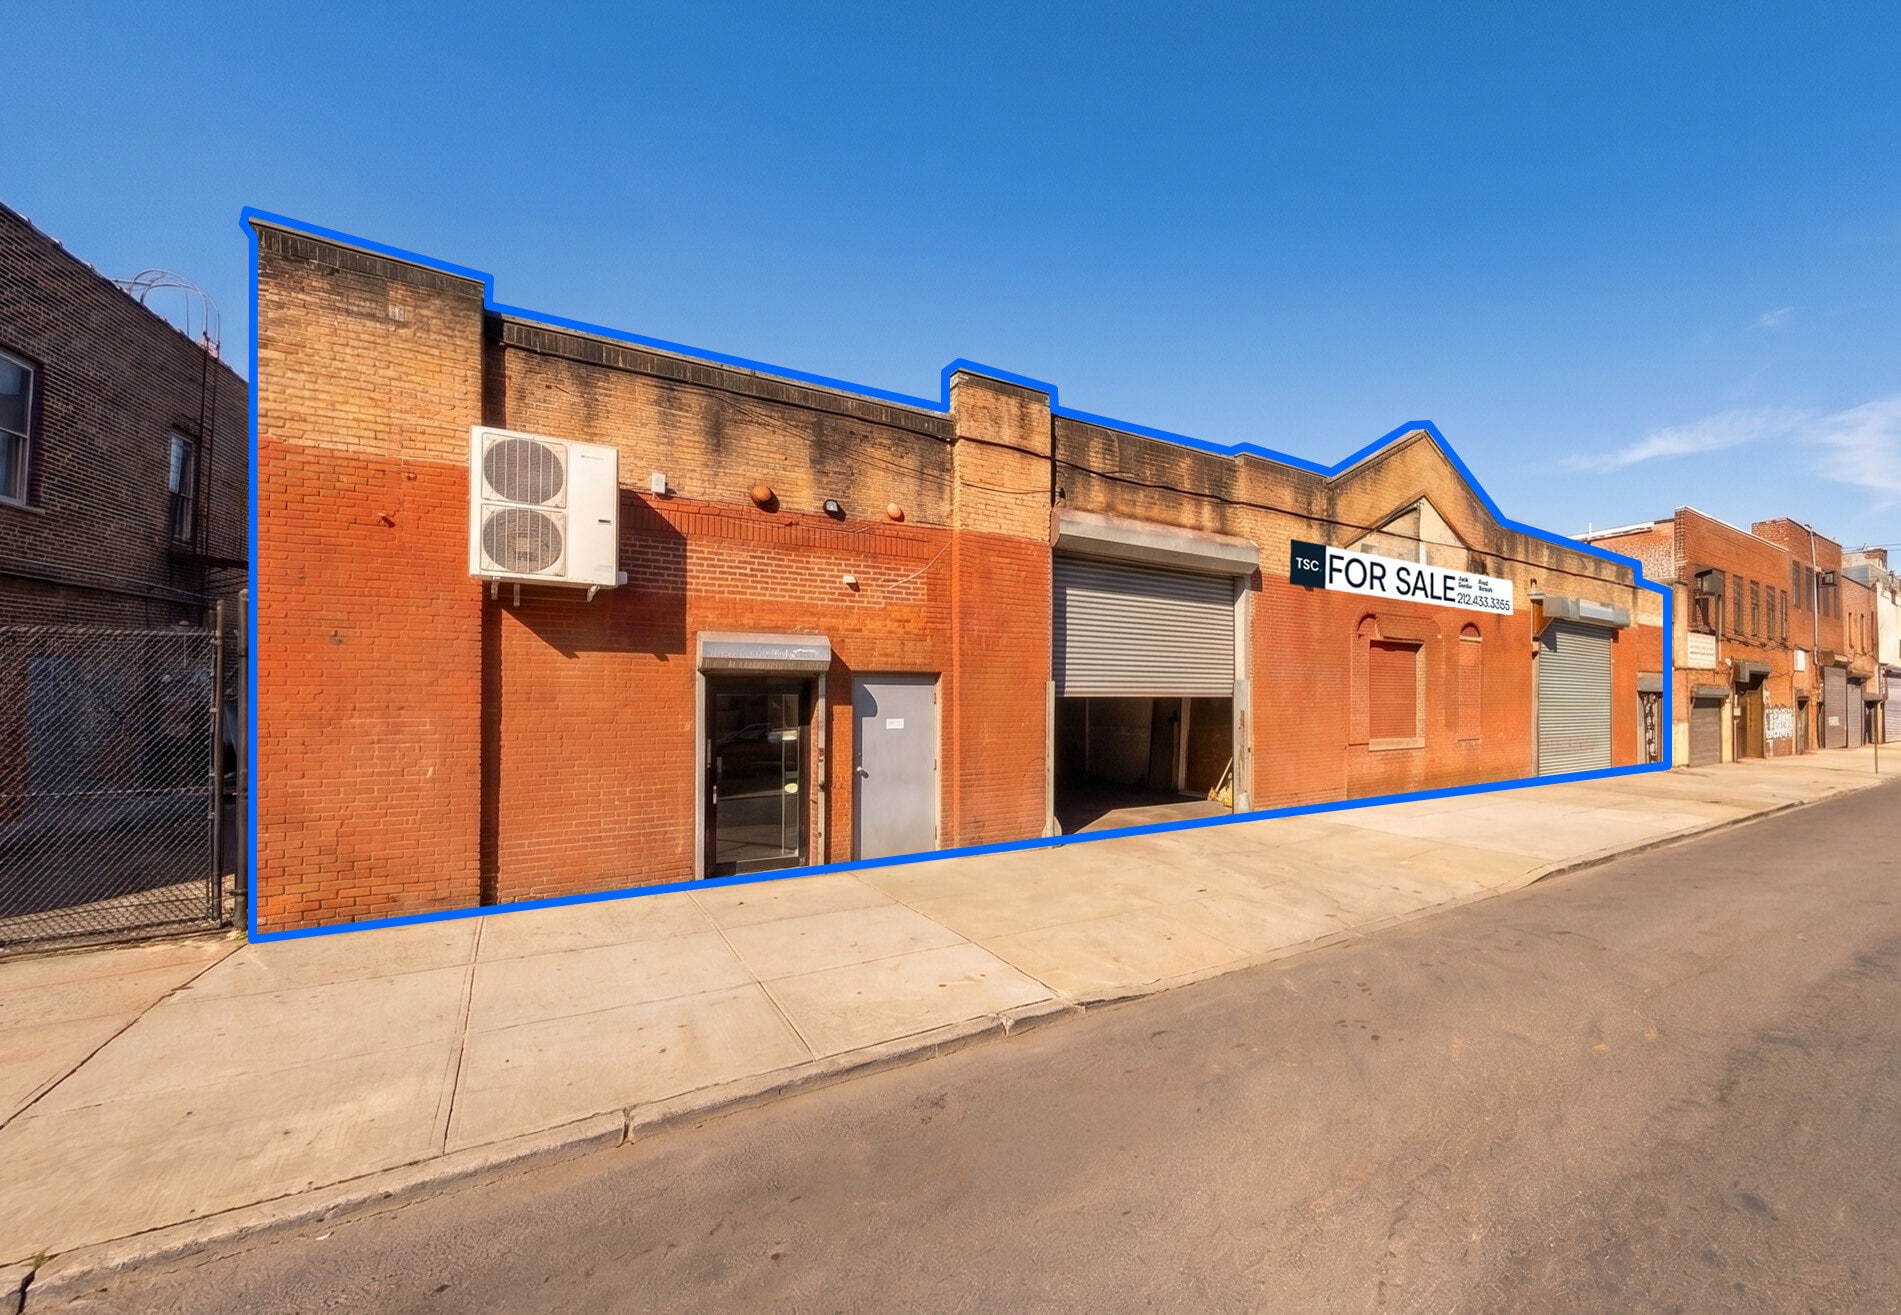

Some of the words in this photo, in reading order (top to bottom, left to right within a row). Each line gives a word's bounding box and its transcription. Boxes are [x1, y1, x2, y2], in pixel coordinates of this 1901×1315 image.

[1328, 553, 1387, 592] FOR
[1396, 566, 1456, 602] SALE
[1457, 592, 1511, 611] 212.433.3355
